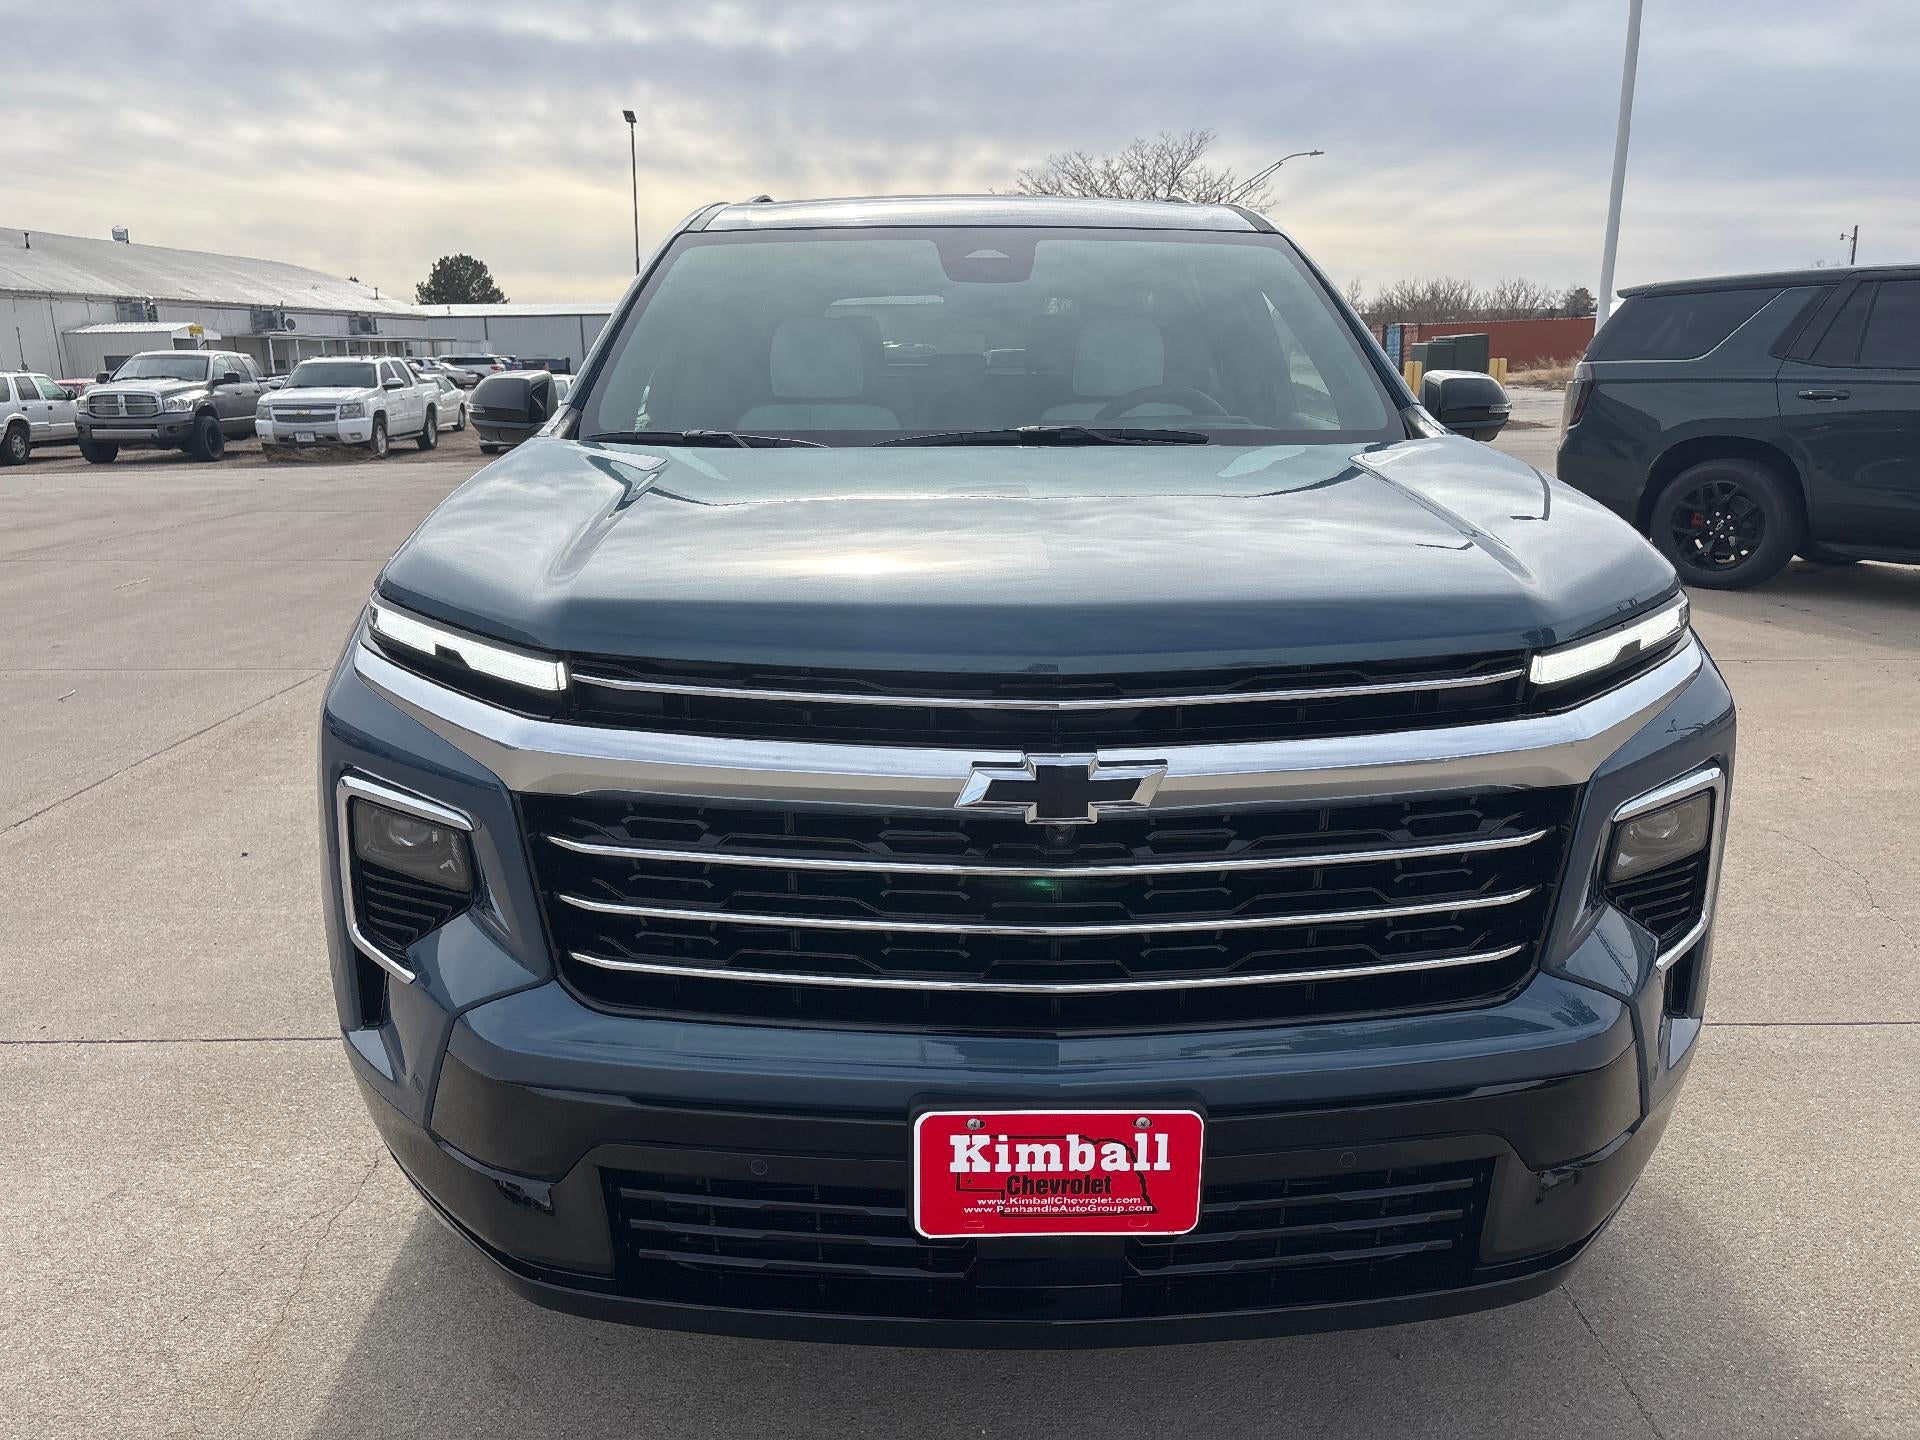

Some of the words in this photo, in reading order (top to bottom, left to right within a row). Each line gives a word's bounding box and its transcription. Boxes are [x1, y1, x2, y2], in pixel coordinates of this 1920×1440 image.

[949, 1133, 1171, 1173] Kimball
[1006, 1175, 1112, 1196] Chevrolet
[977, 1196, 1141, 1205] www.KimballChevrolet.com
[964, 1204, 1153, 1213] www.PanhandleAutoGroup.com
